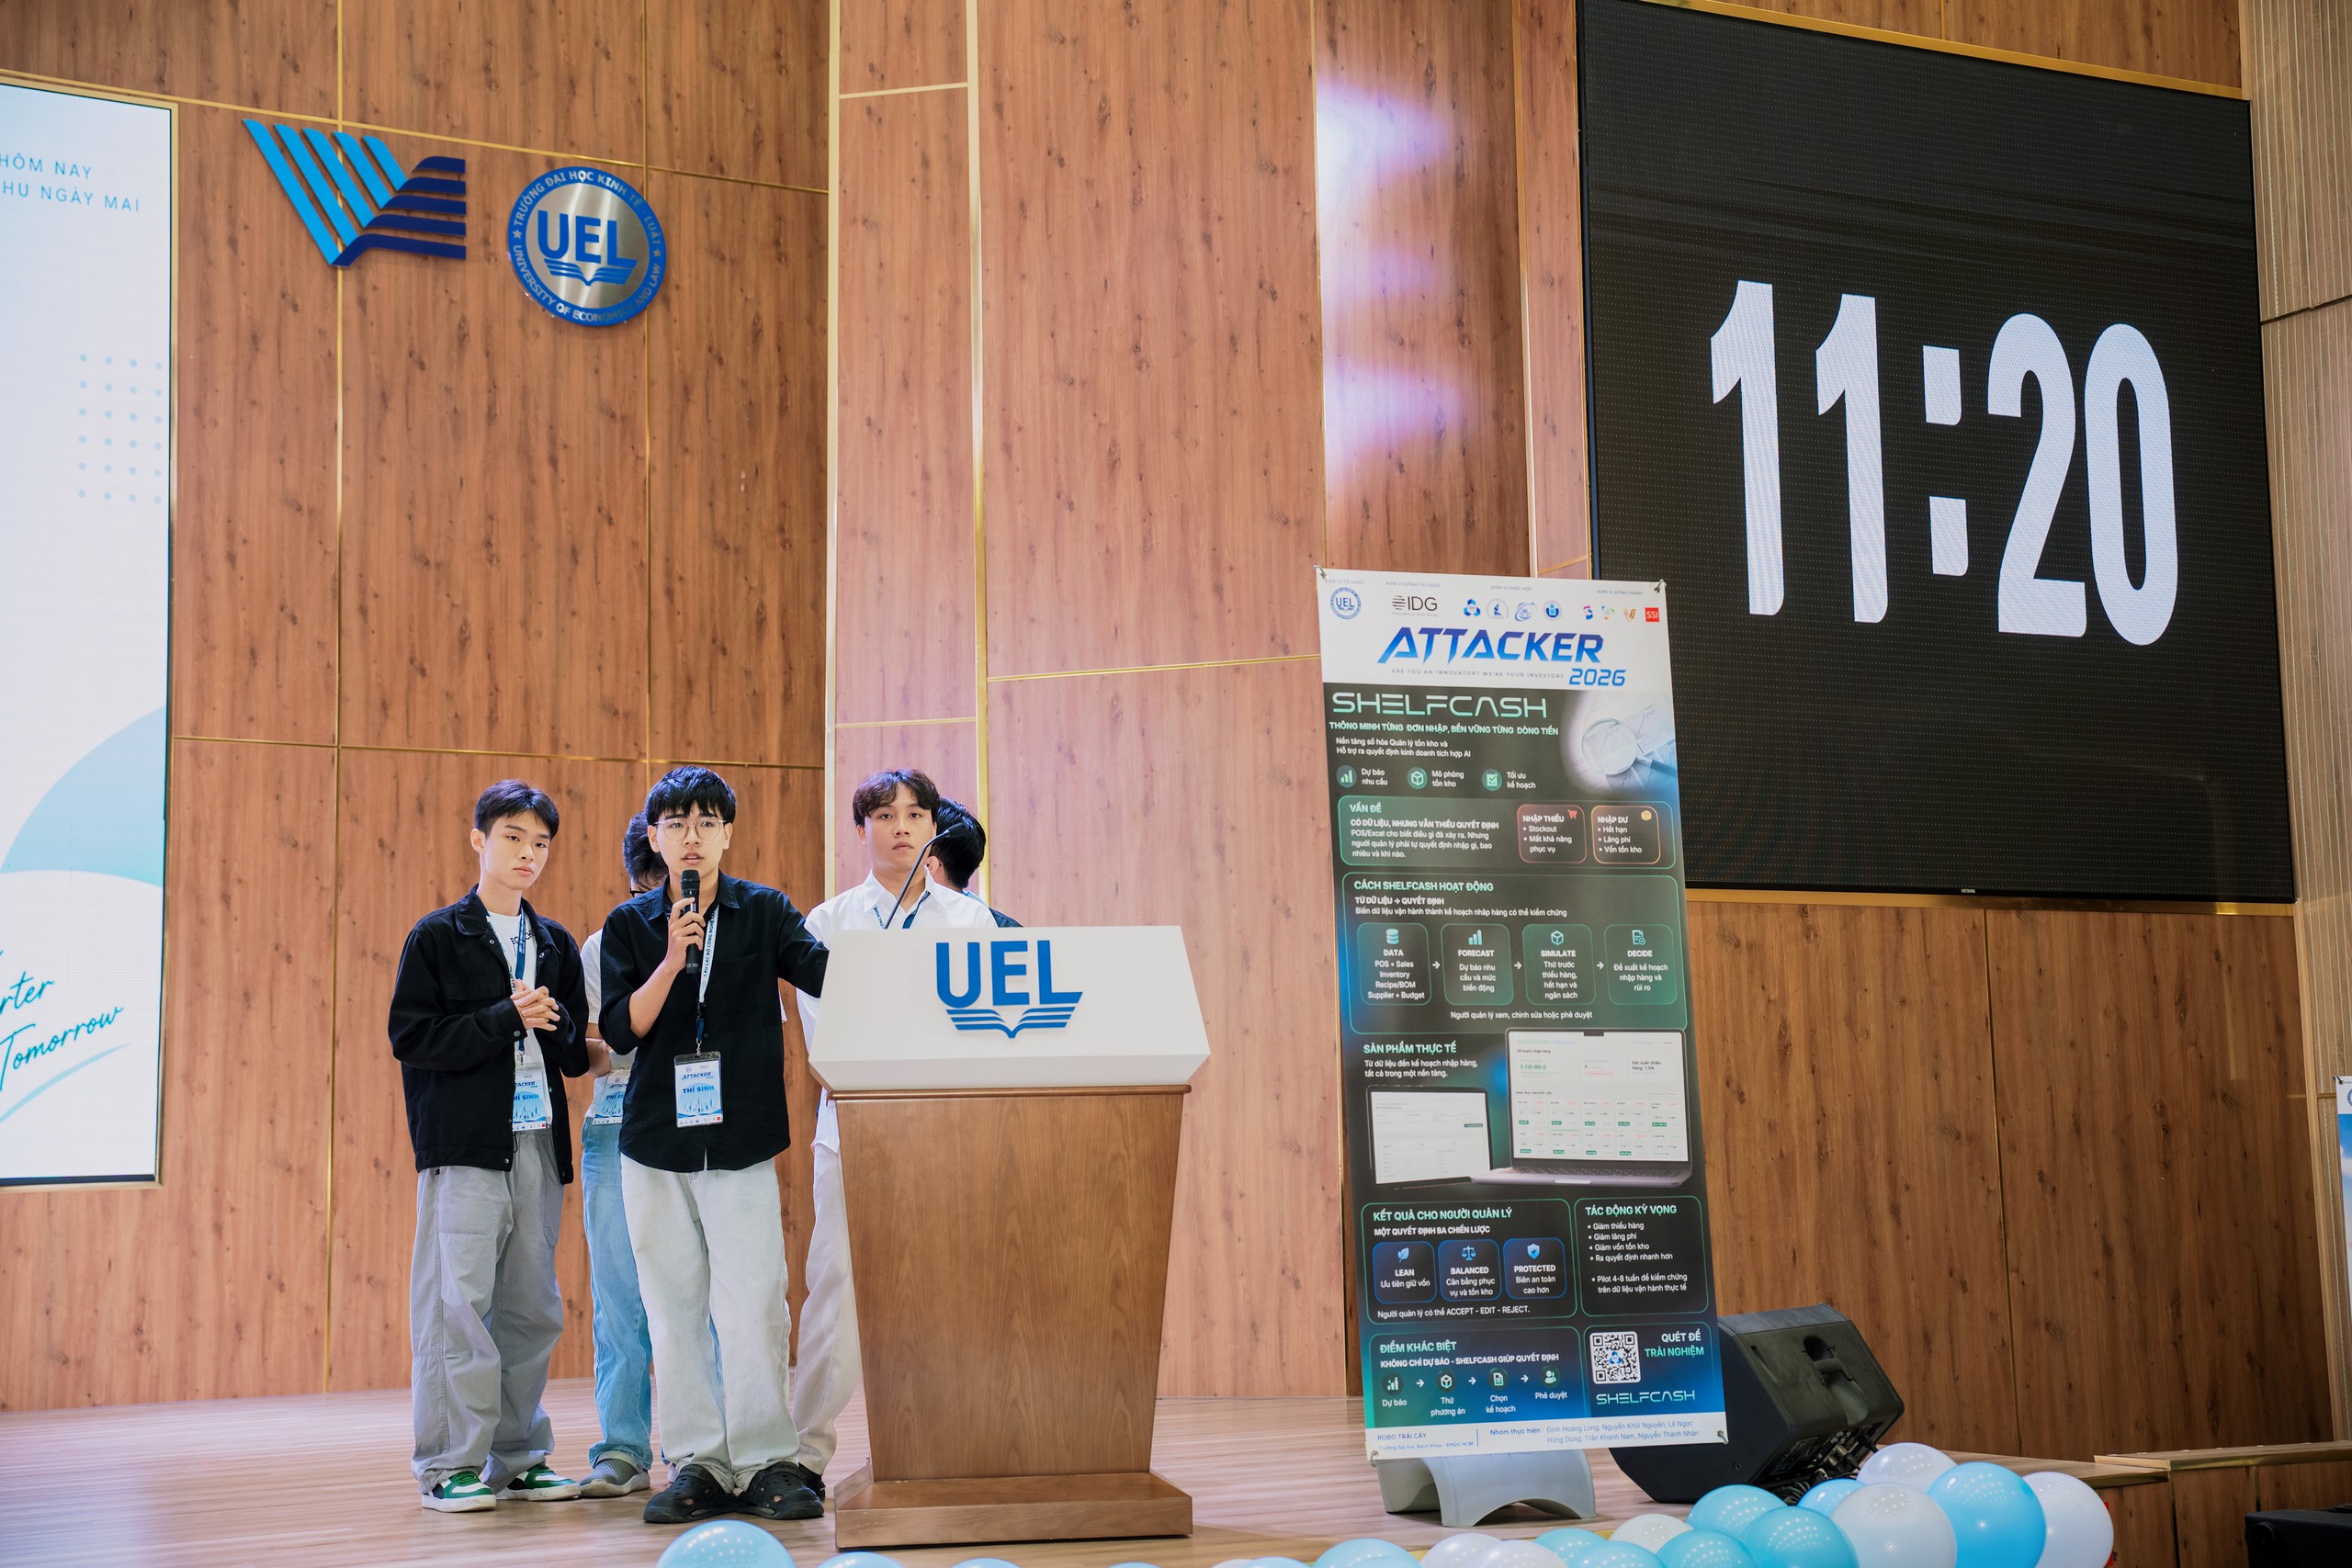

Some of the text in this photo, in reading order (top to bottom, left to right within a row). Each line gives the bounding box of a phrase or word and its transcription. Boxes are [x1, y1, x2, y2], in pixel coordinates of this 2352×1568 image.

[0, 152, 91, 179] HÔM NAY
[41, 186, 93, 206] NGÀY
[105, 195, 139, 212] MAI
[514, 183, 545, 226] TRƯỜNG
[545, 172, 567, 186] ĐẠI
[569, 170, 594, 183] HỌC
[597, 175, 628, 196] KINH
[537, 209, 639, 269] UEL
[514, 244, 662, 322] UNIVERSITY OF ECONOMICS AND LAW
[1711, 280, 2177, 646] 11:20
[1336, 597, 1355, 608] UEL
[1408, 596, 1438, 611] IDG
[1646, 610, 1658, 619] SSI
[1376, 626, 1604, 665] ATTACKER
[1567, 668, 1628, 687] 2026
[1331, 692, 1547, 718] SHELFCASH
[1329, 721, 1559, 736] THÔNG MINH TỪNG ĐƠN NHẬP, BỀN VỮNG TỪNG DÒNG TIỀN
[1336, 737, 1349, 745] Nền
[1351, 738, 1365, 747] tảng
[1366, 737, 1375, 745] số
[1375, 738, 1388, 746] hóa
[1389, 738, 1407, 747] Quản
[1408, 739, 1414, 748] lý
[1414, 739, 1425, 747] tồn
[1362, 768, 1371, 776] Dự
[1431, 770, 1464, 780] Mô phỏng
[1507, 771, 1516, 779] Tối
[1507, 780, 1536, 790] kế hoạch
[1350, 801, 1382, 813] VẤN ĐỀ
[1350, 818, 1499, 830] CÓ DỮ LIỆU, NHƯNG VẪN THIẾU QUYẾT ĐỊNH
[1522, 813, 1565, 824] NHẬP THIẾU
[1598, 816, 1629, 825] NHẬP DƯ
[1353, 879, 1494, 894] CÁCH SHELFCASH HOẠT ĐỘNG
[1354, 895, 1444, 906] TỪ DỮ LIỆU QUYẾT ĐỊNH
[1383, 949, 1404, 957] DATA
[1458, 949, 1495, 957] FORECAST
[935, 940, 1084, 1009] UEL
[1379, 971, 1410, 979] Inventory
[1375, 980, 1416, 989] Recipe/BOM
[1367, 991, 1425, 999] Supplier Budget
[0, 1006, 124, 1091] Tomorrow
[1363, 1040, 1457, 1055] SẢN PHẨM THỰC TẾ
[682, 1071, 712, 1081] ATTACKER
[1373, 1207, 1512, 1222] KẾT QUẢ CHO NGƯỜI QUẢN LÝ
[1585, 1203, 1677, 1217] TÁC ĐỘNG KỲ VỌNG
[1374, 1224, 1490, 1237] MỘT QUYẾT ĐỊNH BA CHIẾN LƯỢC
[1450, 1267, 1489, 1275] BALANCED
[1513, 1265, 1556, 1273] PROTECTED
[1661, 1328, 1702, 1343] QUÉT ĐỂ
[1379, 1339, 1457, 1354] ĐIỂM KHÁC BIỆT
[1644, 1345, 1704, 1358] TRẢI NGHIỆM
[1380, 1352, 1559, 1369] KHÔNG CHỈ DỰ BÁO SHELFCASH GIÚP QUYẾT ĐỊNH
[1596, 1390, 1696, 1404] SHELFCASH
[1510, 1427, 1526, 1436] thực
[1527, 1426, 1541, 1435] hiện
